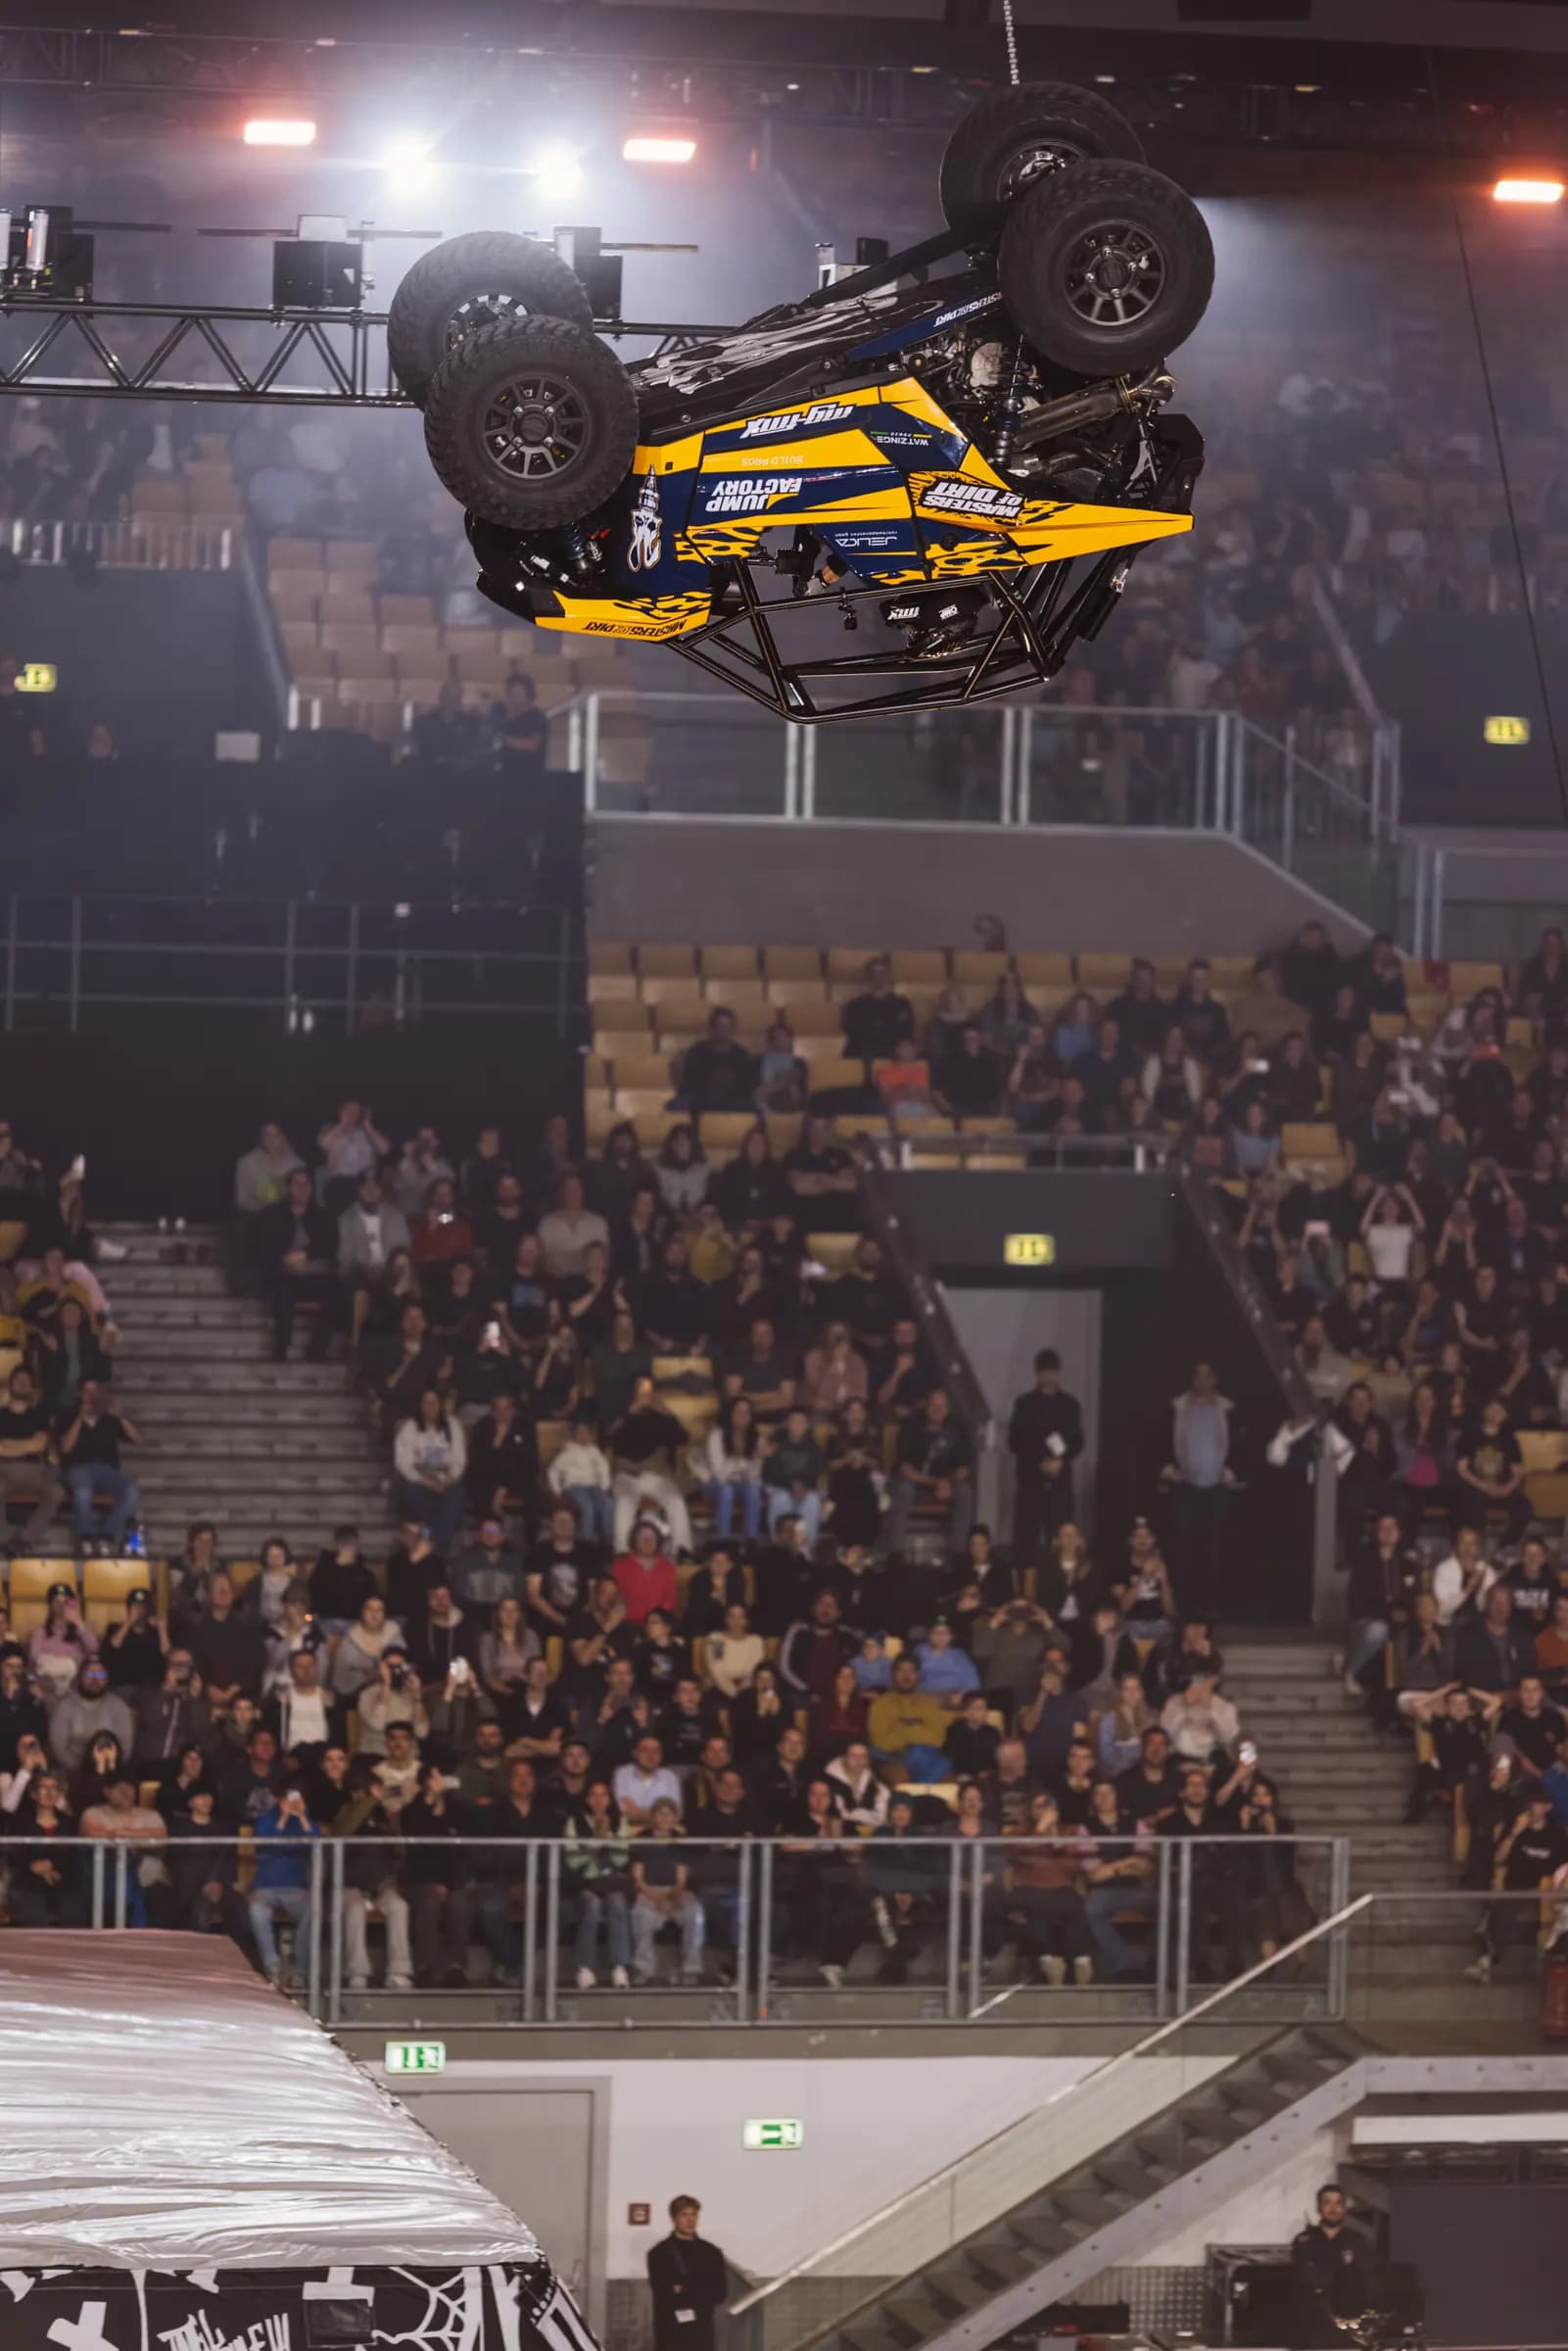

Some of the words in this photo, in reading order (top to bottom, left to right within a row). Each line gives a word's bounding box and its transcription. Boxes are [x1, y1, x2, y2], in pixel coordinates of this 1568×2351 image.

[932, 310, 957, 327] DIRT
[740, 456, 770, 466] PROS
[772, 455, 804, 465] BUILD
[711, 477, 803, 497] FACTORY
[927, 481, 999, 503] DIRT
[705, 494, 770, 512] JUMP
[922, 495, 1021, 517] MASTERS
[995, 492, 1023, 506] OF
[834, 536, 898, 548] JELICA
[581, 621, 616, 633] DIRT
[629, 618, 688, 638] MASTERS
